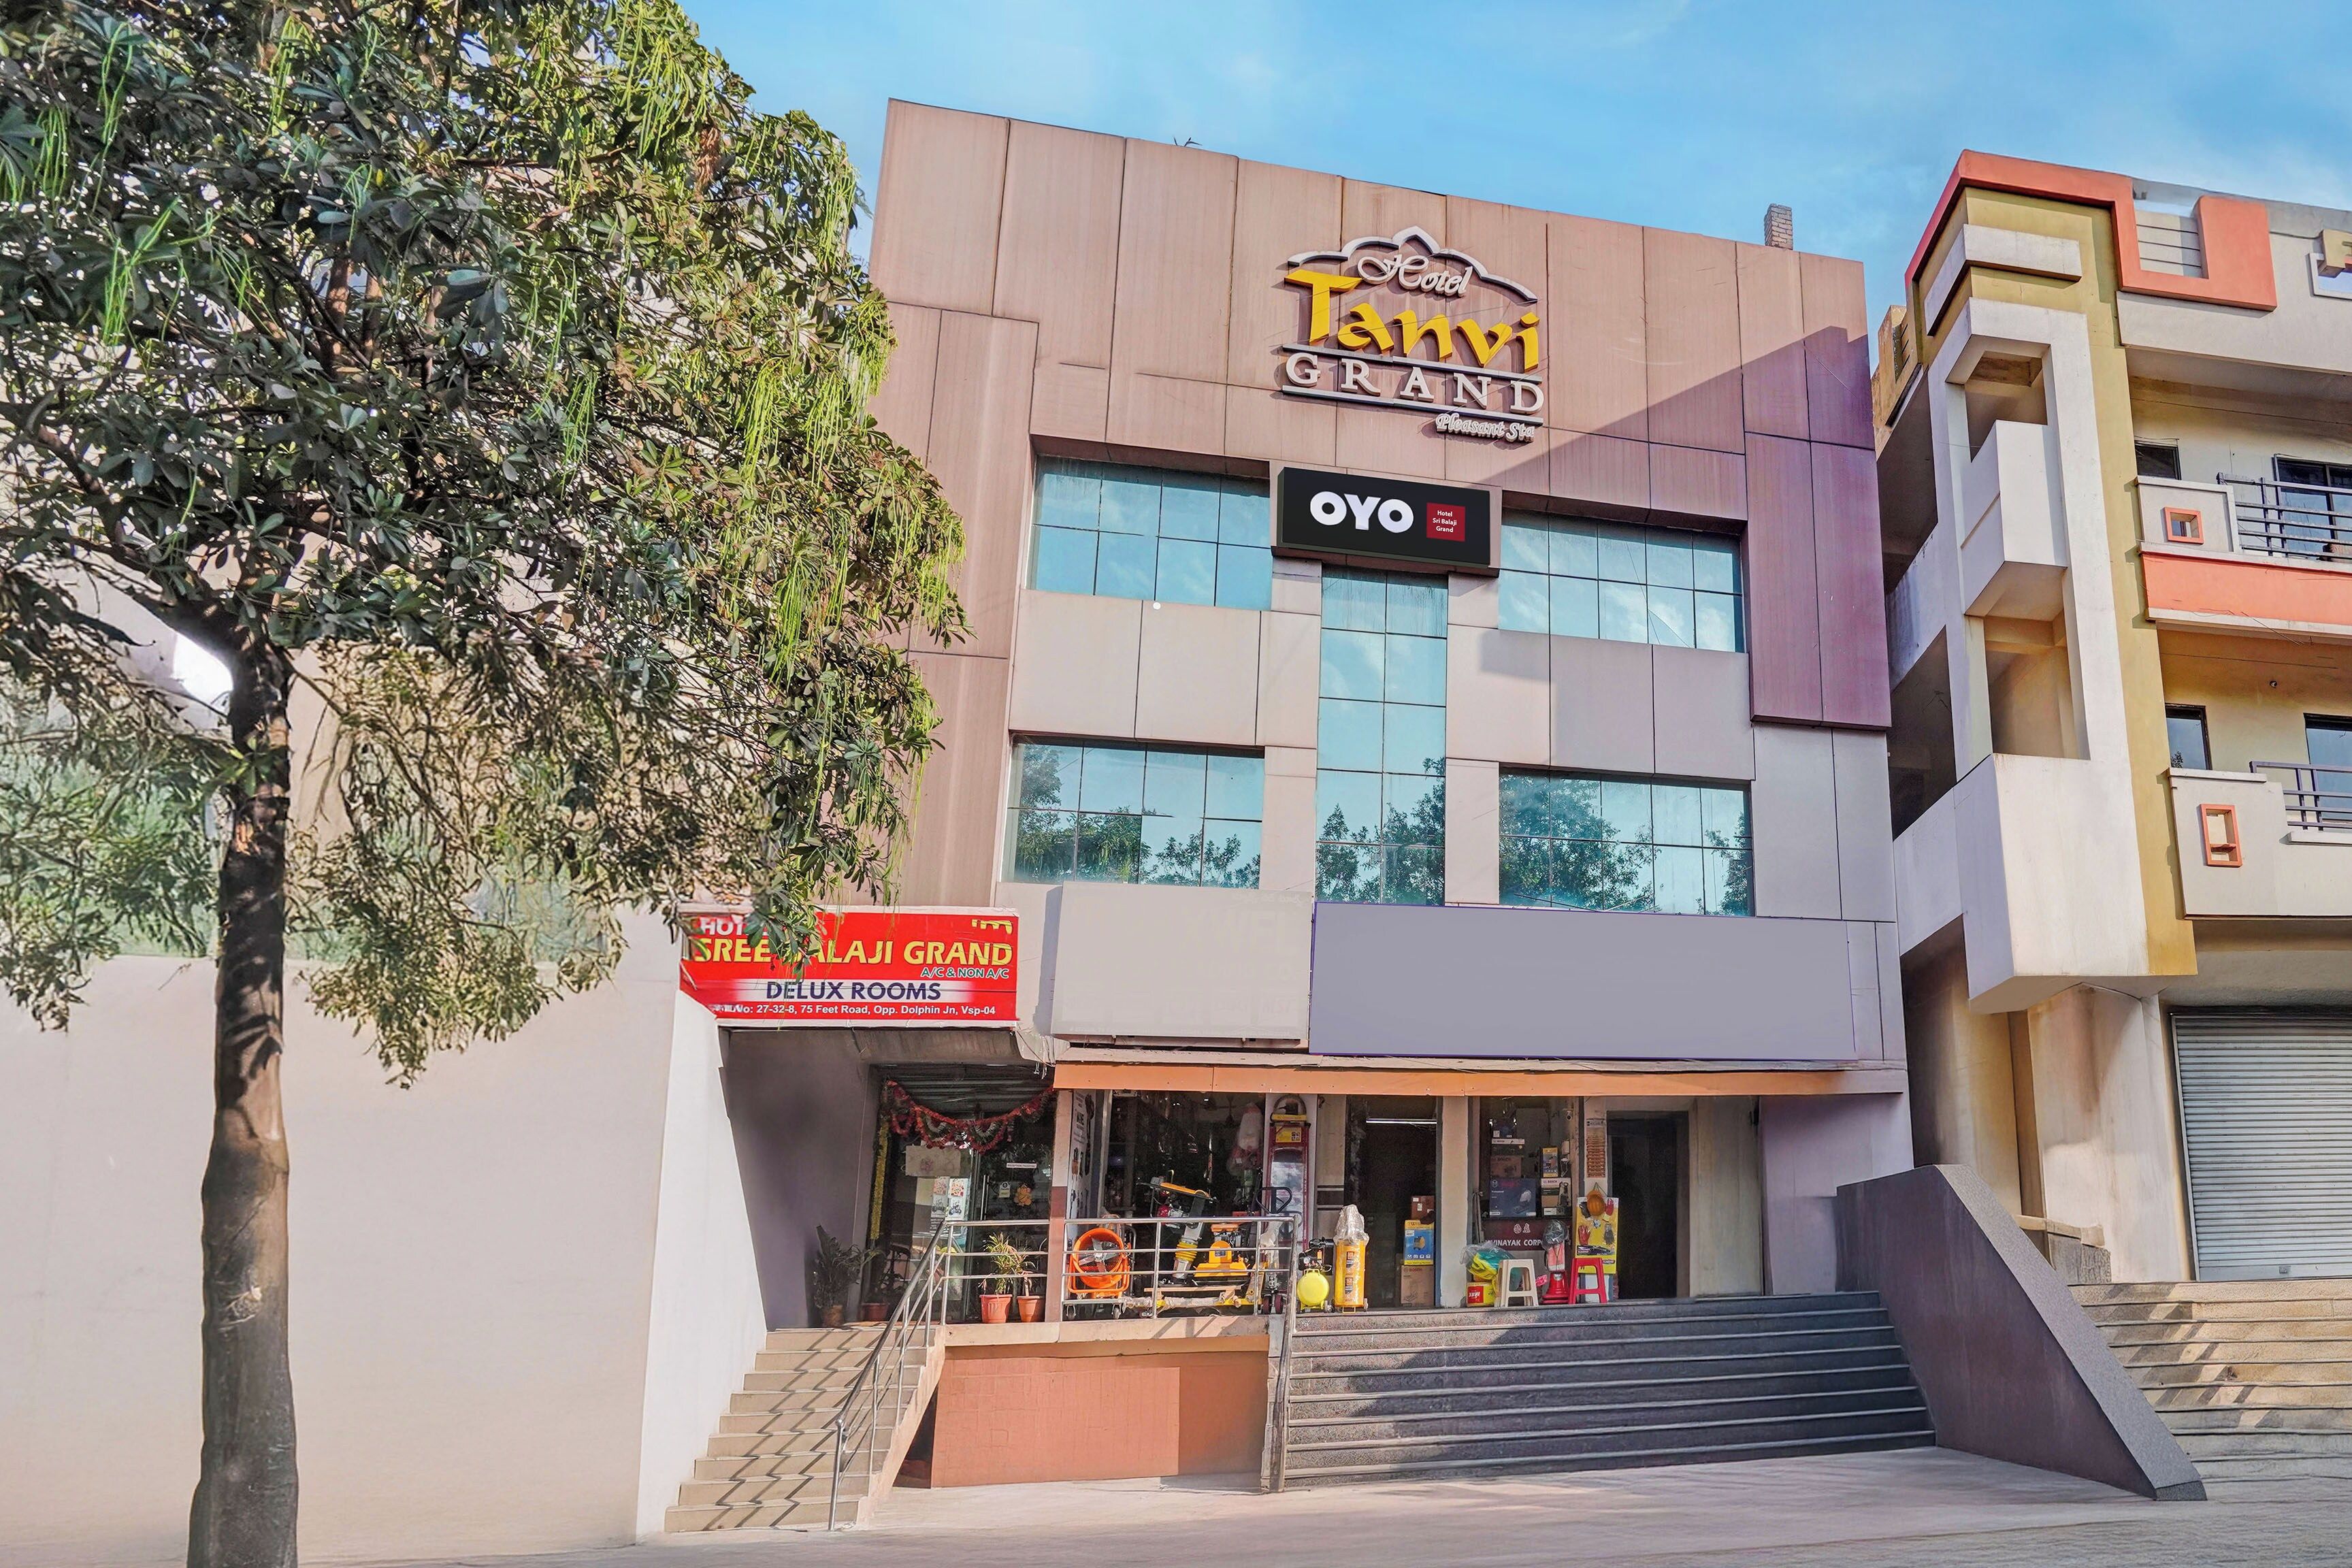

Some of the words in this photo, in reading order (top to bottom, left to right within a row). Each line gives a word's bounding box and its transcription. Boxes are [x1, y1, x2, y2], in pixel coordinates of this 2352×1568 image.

[1357, 253, 1473, 297] Hotel
[1284, 269, 1540, 373] Tanvi
[1286, 353, 1544, 414] GRAND
[1436, 412, 1505, 438] Pleasant
[1310, 491, 1414, 534] OYO
[1441, 519, 1457, 527] Balaji
[904, 941, 1013, 966] GRAND
[921, 966, 945, 978] A/C
[947, 967, 956, 977] &
[958, 967, 984, 978] NON
[986, 968, 1009, 979] A/C
[766, 981, 844, 1000] DELUX
[851, 982, 941, 1000] ROOMS
[756, 1004, 798, 1015] 27-32-8,
[800, 1004, 813, 1013] 75
[816, 1005, 838, 1013] Feet
[841, 1005, 871, 1015] Road,
[873, 1005, 898, 1015] Opp.
[901, 1006, 941, 1015] Dolphin
[943, 1006, 958, 1015] Jn,
[961, 1006, 996, 1016] Vsp-04
